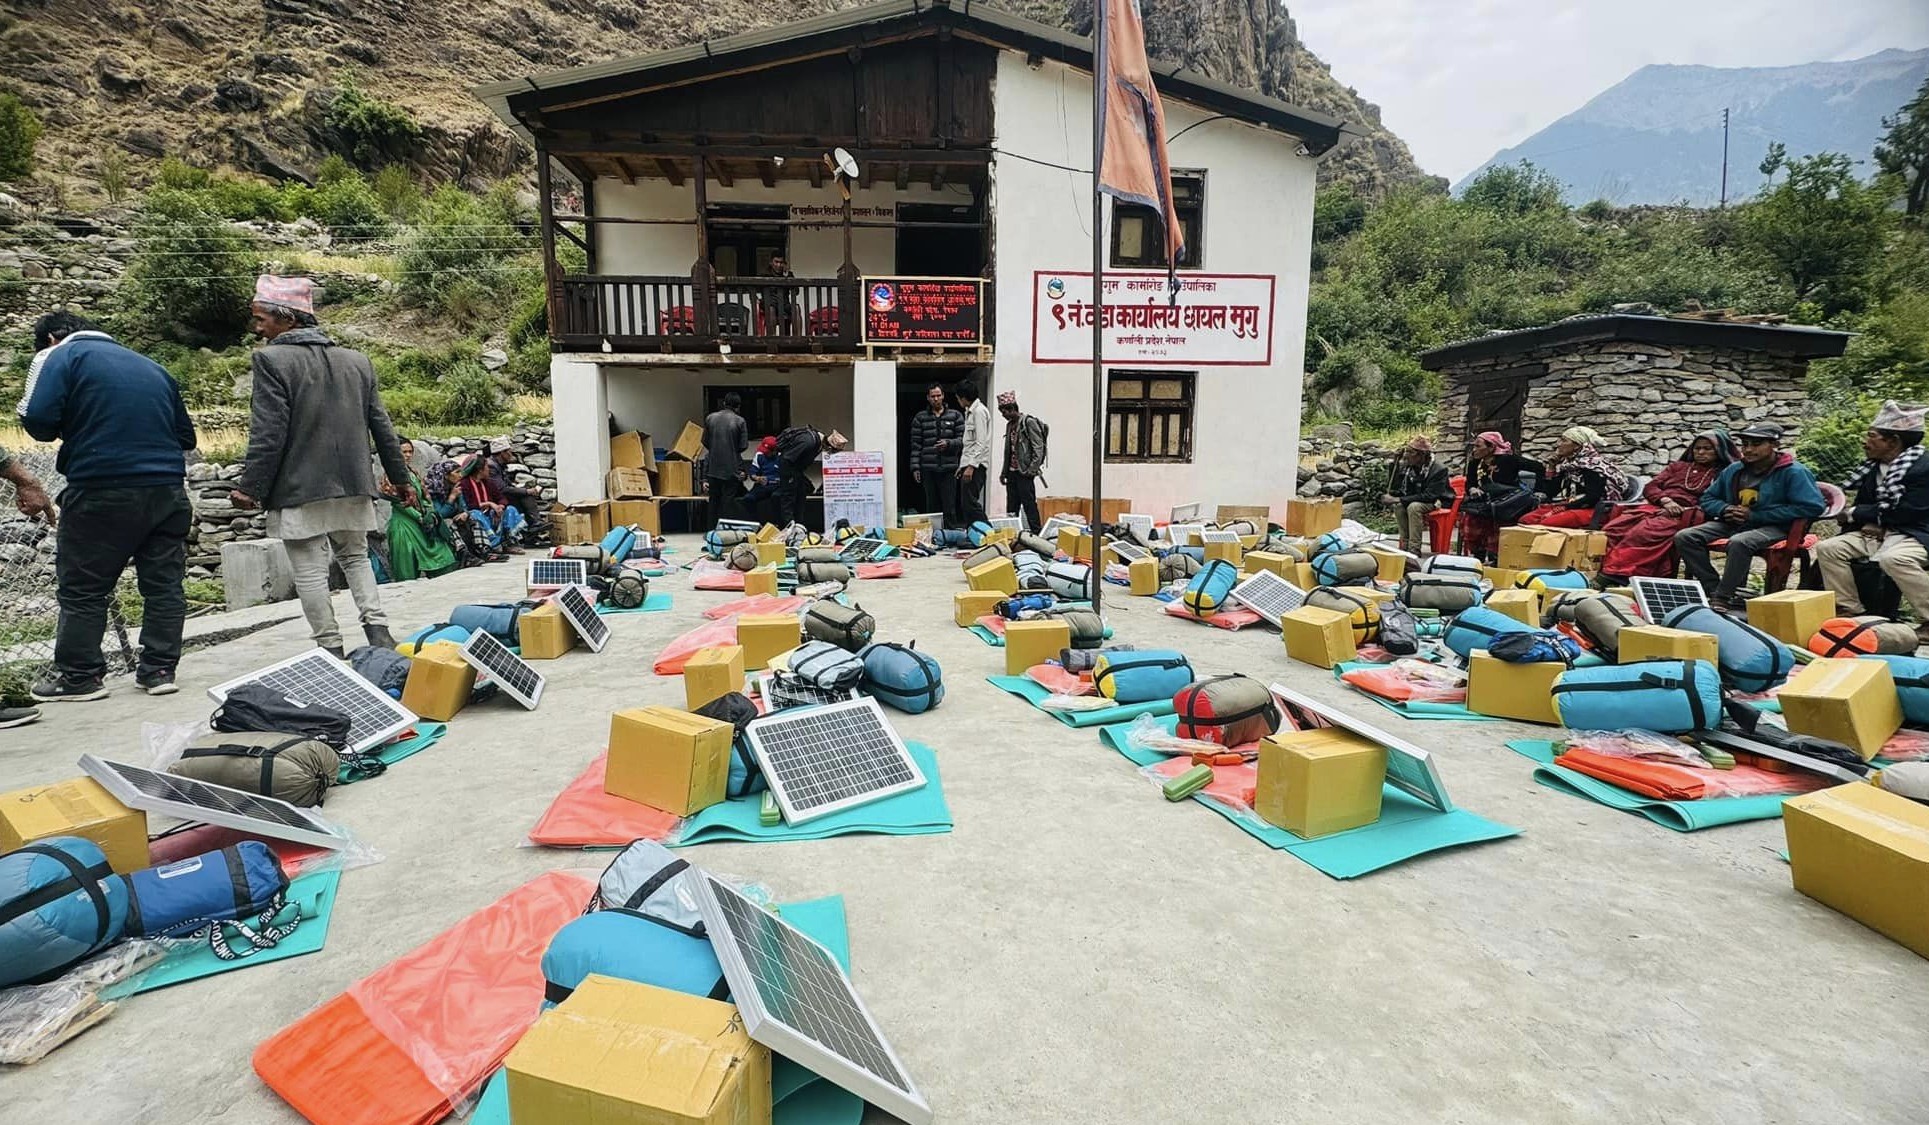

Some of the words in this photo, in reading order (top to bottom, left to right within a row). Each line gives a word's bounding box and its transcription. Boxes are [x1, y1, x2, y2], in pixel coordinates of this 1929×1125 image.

[1116, 296, 1181, 329] कार्यालय
[1184, 305, 1228, 331] छायल
[1229, 305, 1260, 339] मुगु
[1165, 334, 1186, 345] नेपाल
